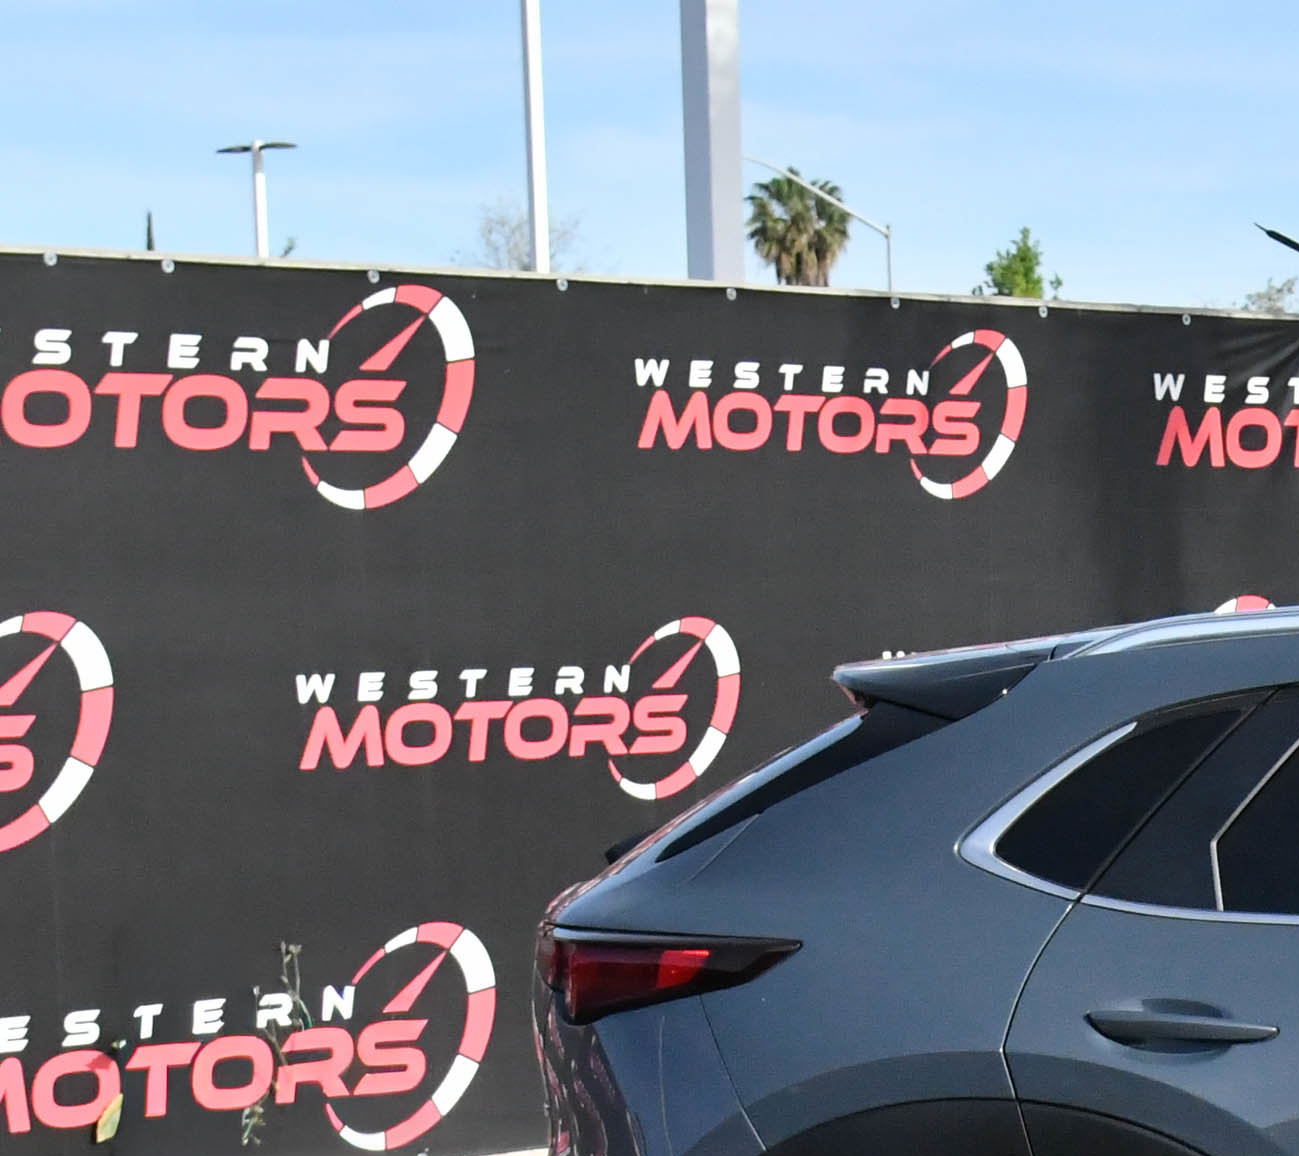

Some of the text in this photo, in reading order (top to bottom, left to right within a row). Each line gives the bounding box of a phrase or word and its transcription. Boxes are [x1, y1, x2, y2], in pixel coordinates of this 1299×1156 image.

[634, 358, 931, 397] WESTERN
[637, 389, 981, 457] MOTORS
[295, 664, 631, 704] WESTERN
[299, 693, 688, 771] MOTORS
[0, 985, 356, 1054] ESTERN
